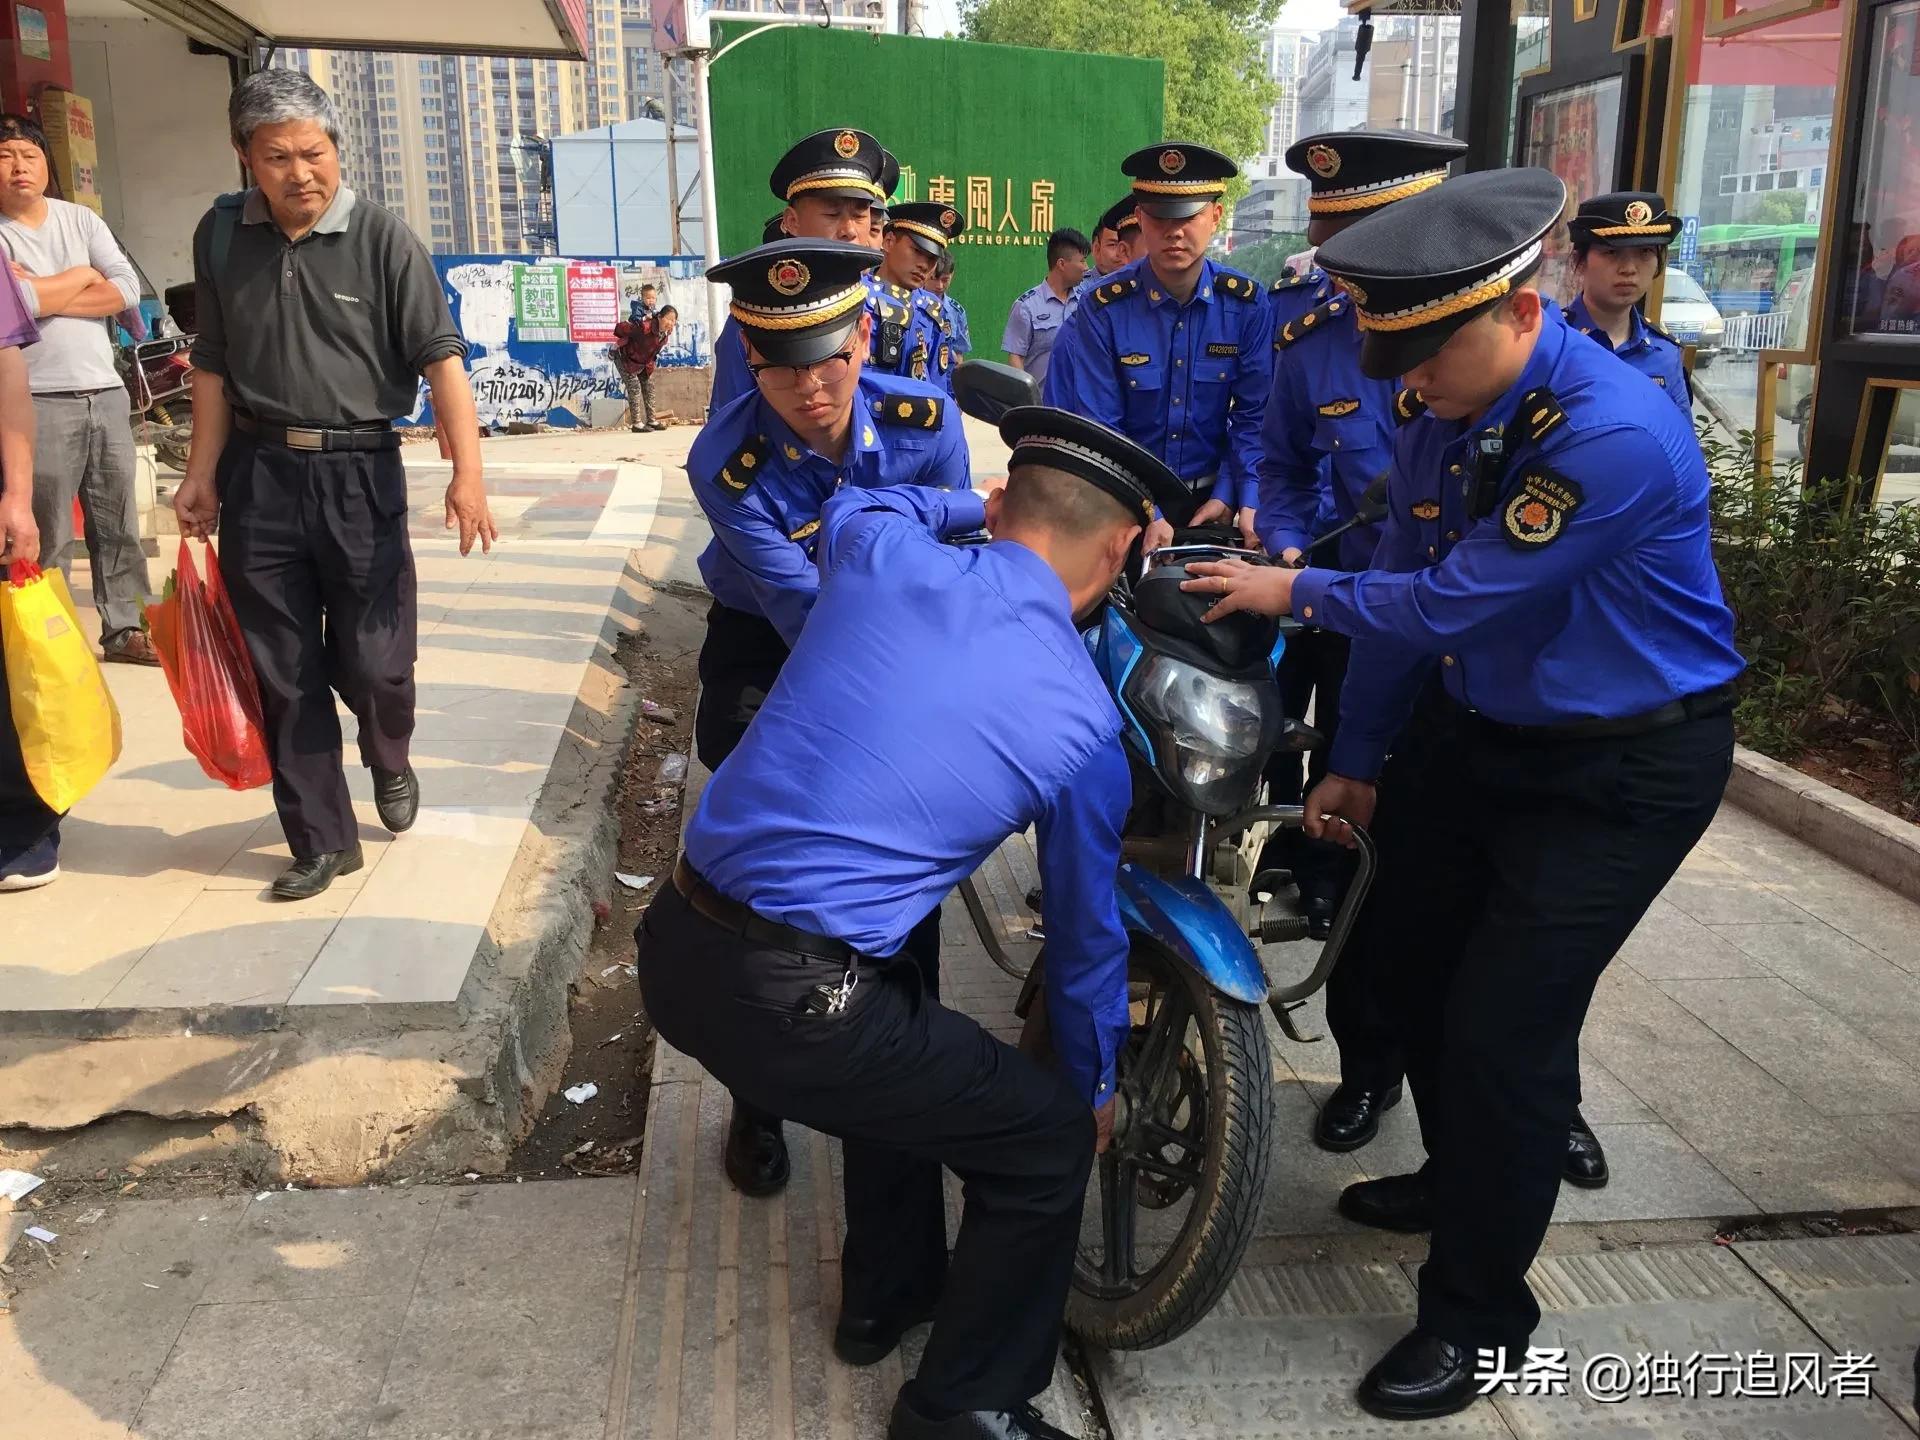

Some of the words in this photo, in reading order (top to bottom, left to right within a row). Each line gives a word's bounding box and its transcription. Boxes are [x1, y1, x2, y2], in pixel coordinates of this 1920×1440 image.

[521, 274, 557, 285] 中公教育
[569, 276, 615, 289] 公益讲座
[525, 288, 554, 303] 教师
[525, 303, 556, 318] 考试
